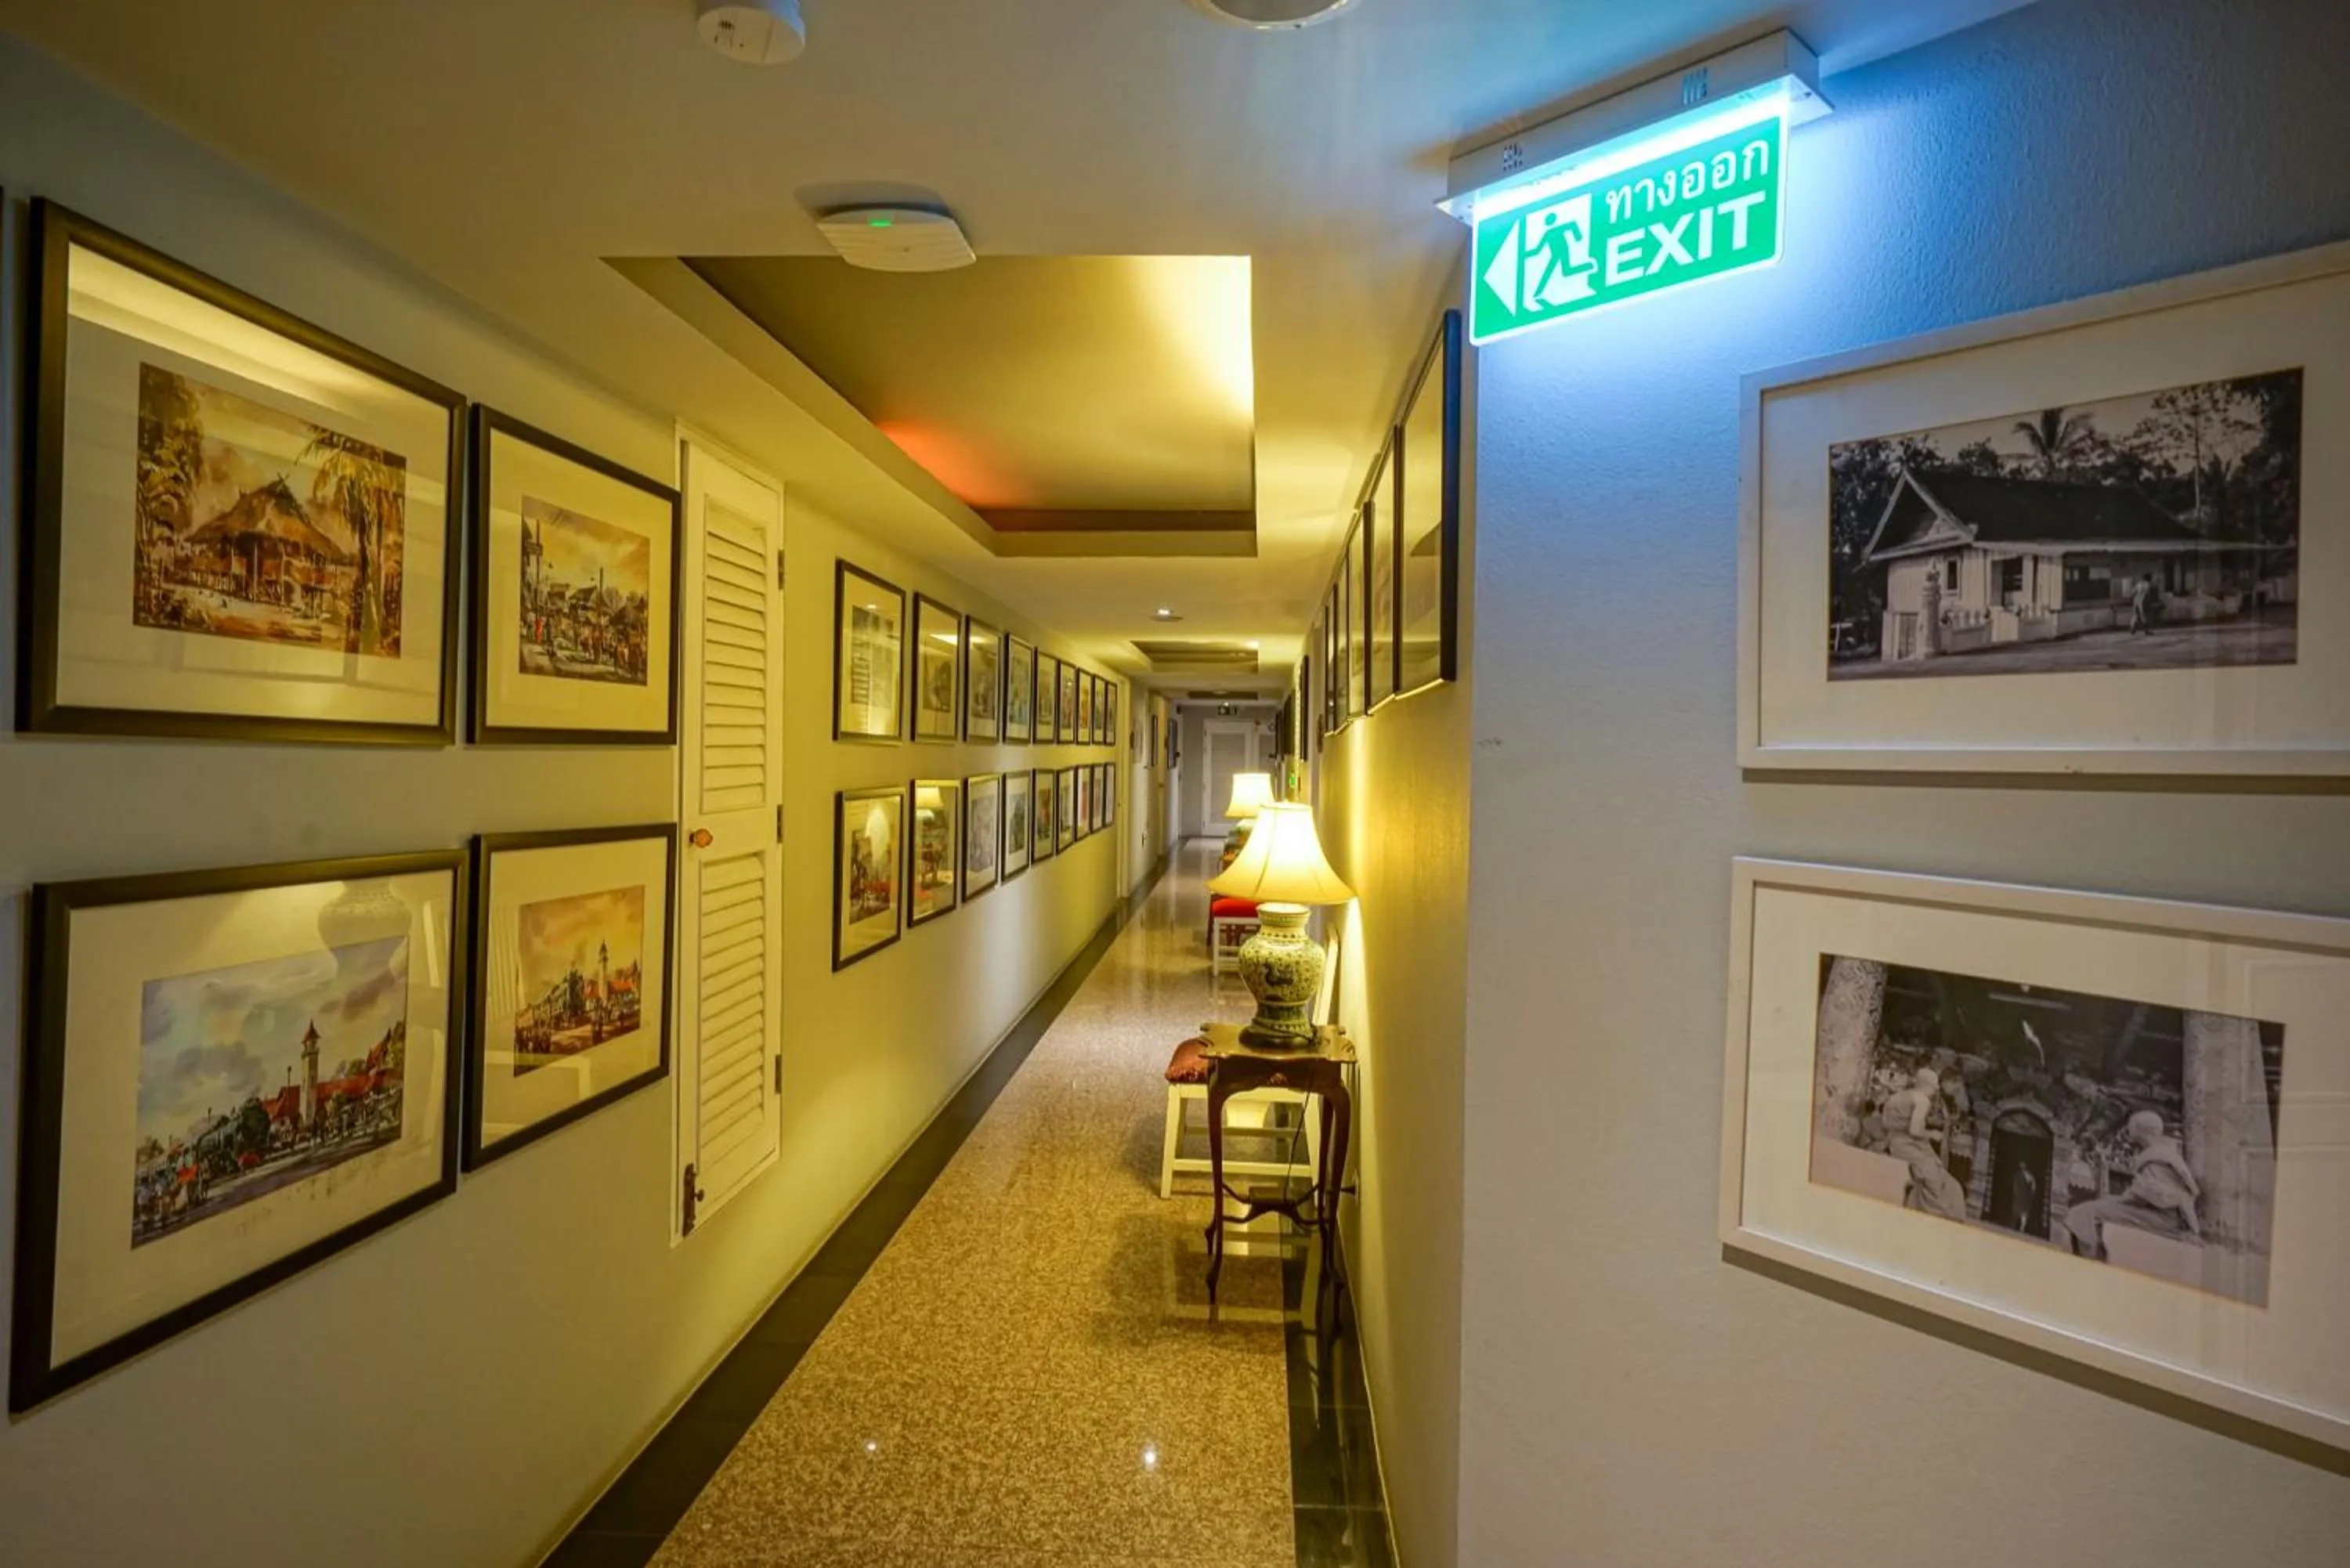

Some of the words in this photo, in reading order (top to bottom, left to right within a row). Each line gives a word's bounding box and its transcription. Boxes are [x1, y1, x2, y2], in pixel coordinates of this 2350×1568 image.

[1606, 139, 1769, 223] ทางออก
[1605, 190, 1766, 287] EXIT
